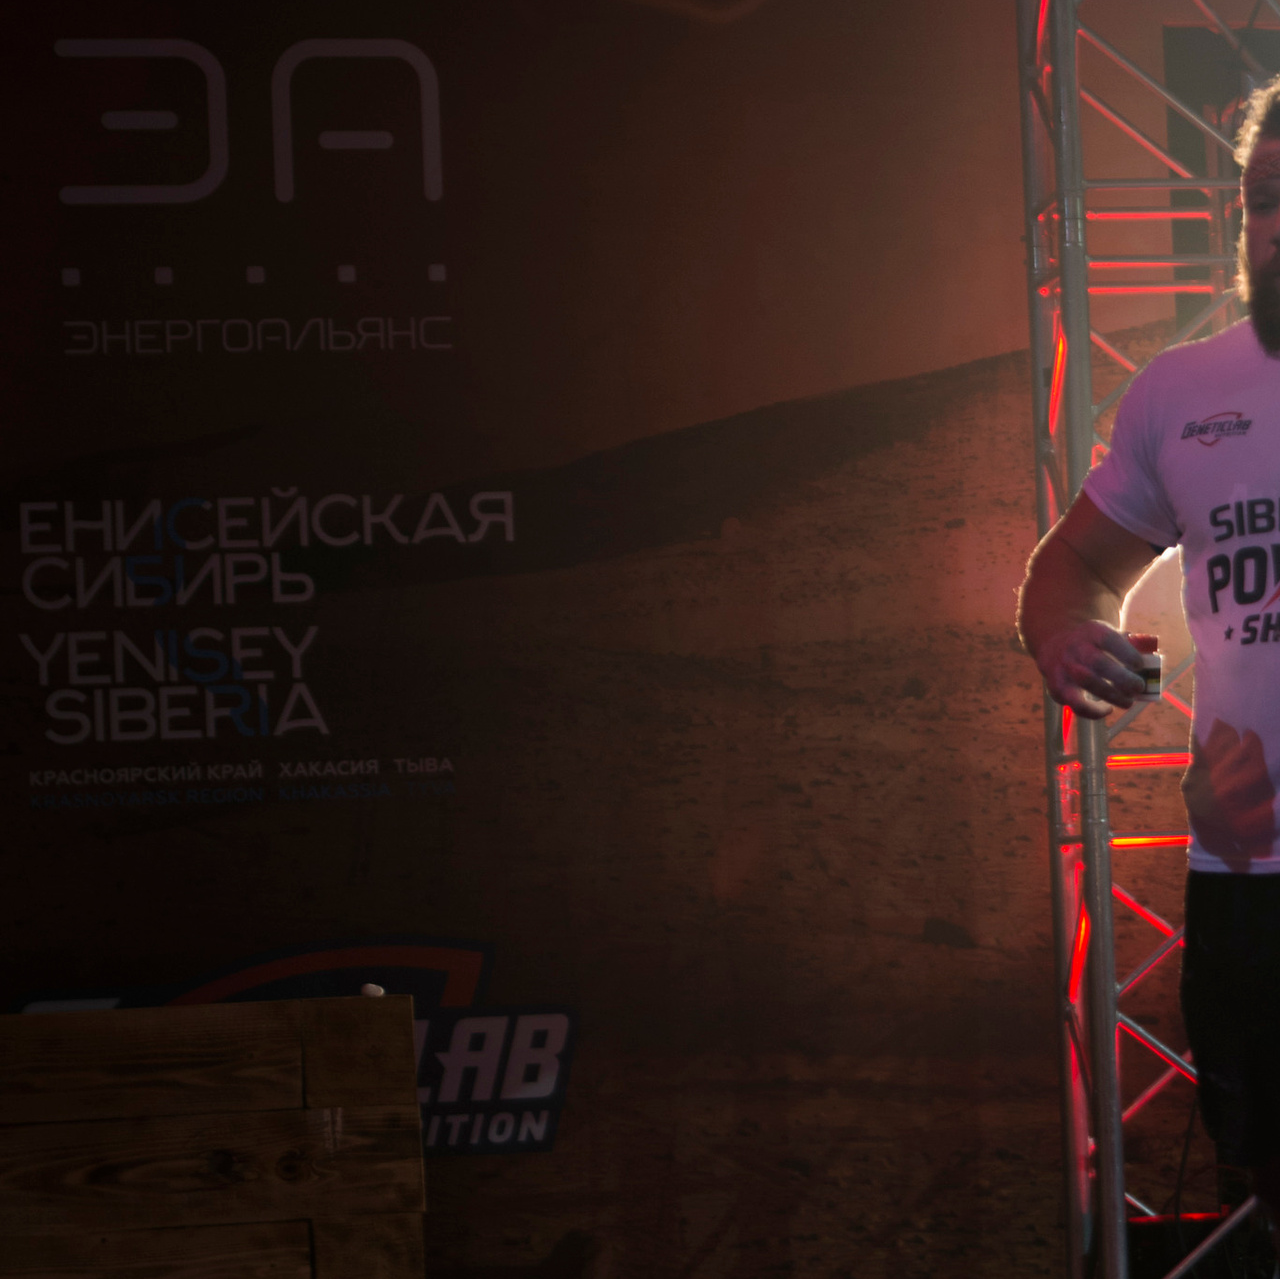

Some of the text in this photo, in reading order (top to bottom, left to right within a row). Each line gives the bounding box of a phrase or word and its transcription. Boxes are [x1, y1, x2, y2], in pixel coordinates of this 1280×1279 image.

[54, 38, 443, 204] ЭА
[64, 316, 453, 355] ЭНЕРГОАЛЬЯНС
[19, 487, 515, 554] ЕНИСЕЙСКАЯ
[21, 551, 316, 611] СИБИРЬ
[18, 625, 319, 687] YENISEY
[44, 682, 330, 745] SIBERIA
[29, 756, 454, 787] КРАСНОЯРСКИЙ КРАЙ ХАКАСИЯ ТЫВА
[186, 787, 264, 805] REGION
[421, 1110, 549, 1147] ITION
